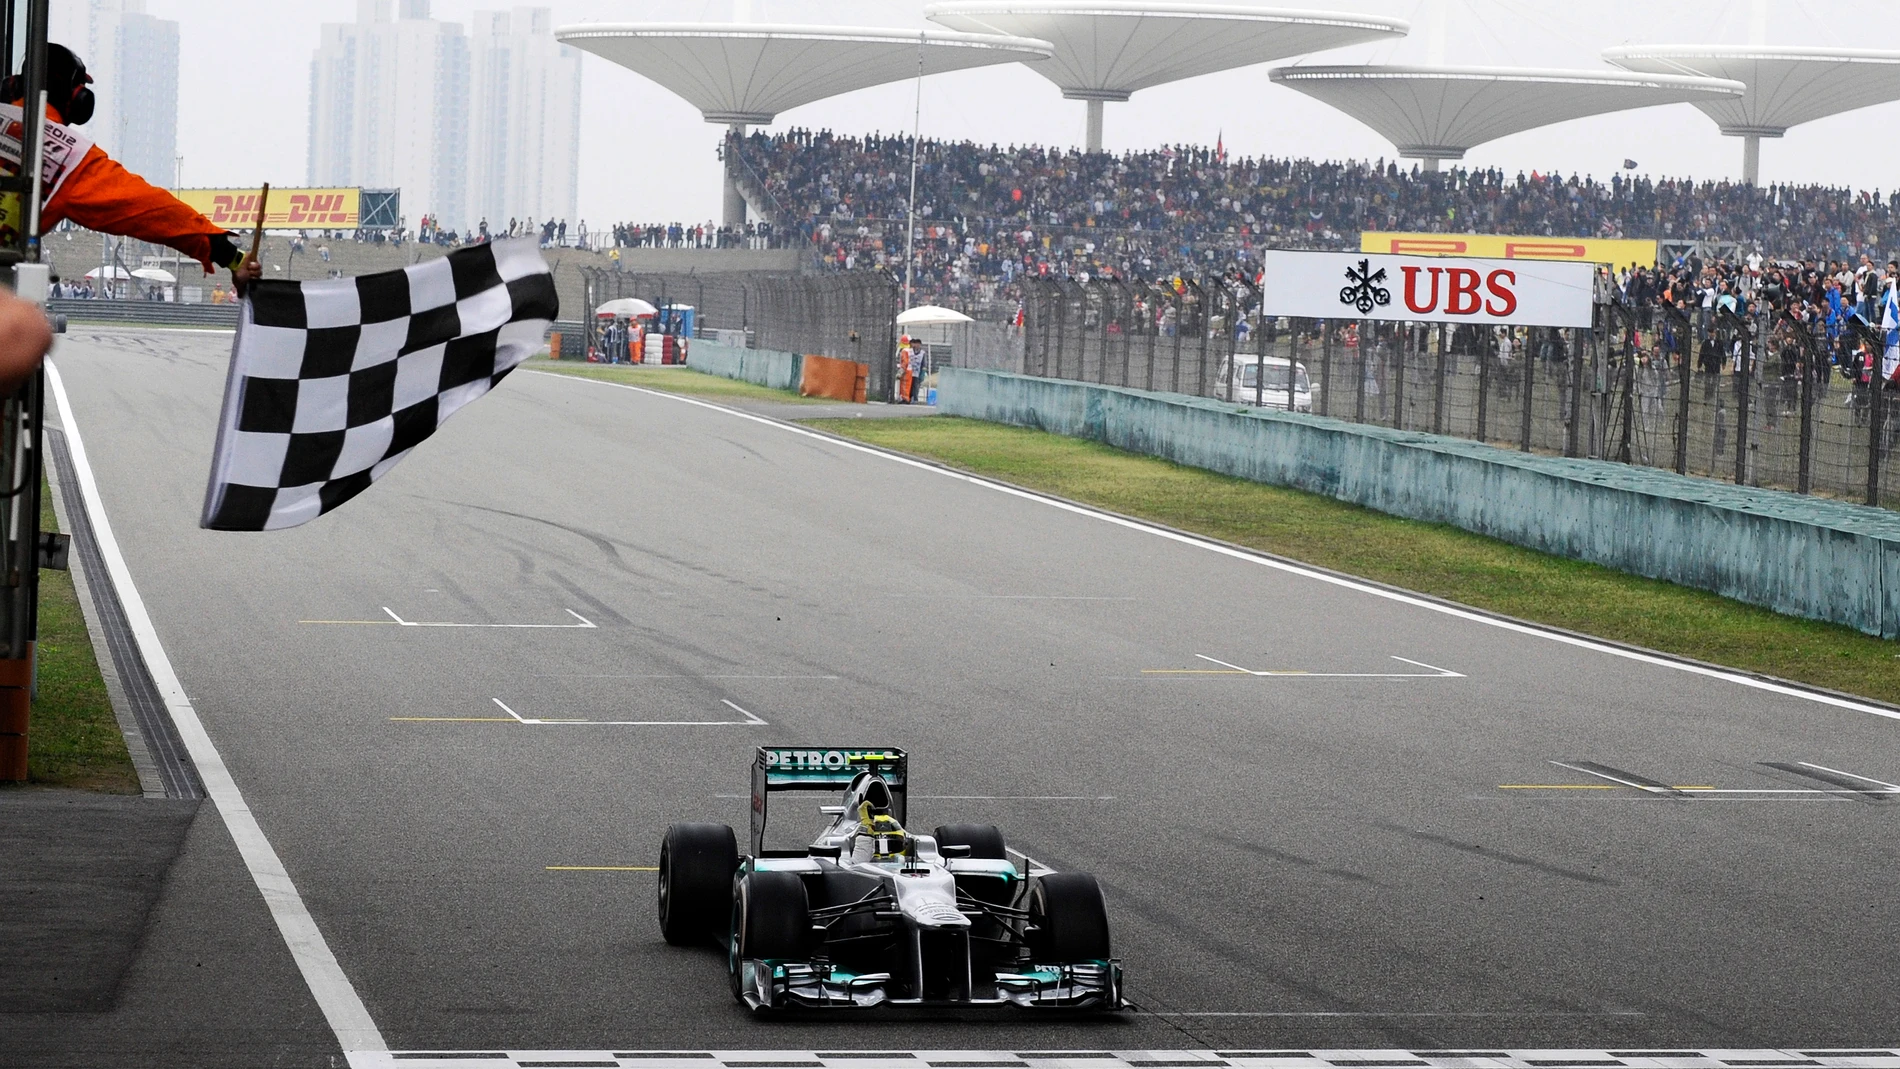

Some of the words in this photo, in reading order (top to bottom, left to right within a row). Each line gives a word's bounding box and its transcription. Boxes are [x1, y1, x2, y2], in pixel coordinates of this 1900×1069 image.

[44, 124, 76, 146] 2012
[212, 195, 268, 223] DHL
[287, 195, 348, 223] DHL
[1400, 266, 1517, 317] UBS
